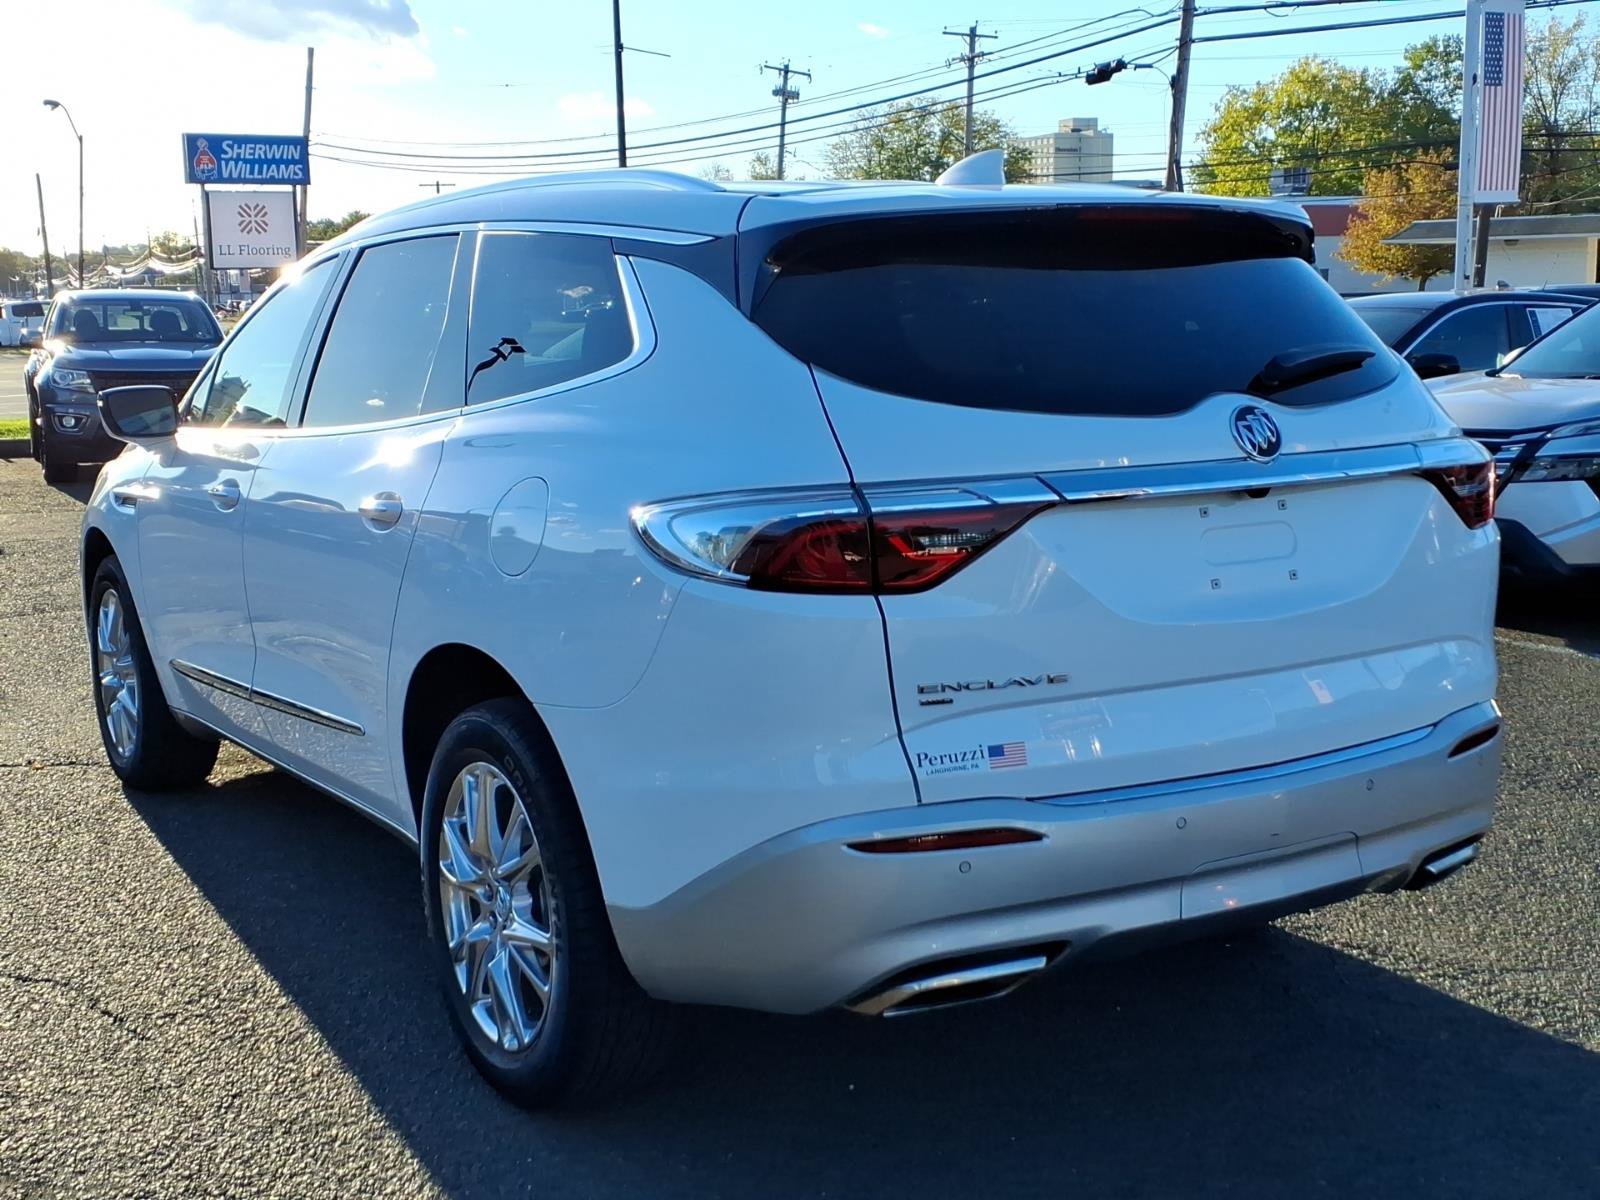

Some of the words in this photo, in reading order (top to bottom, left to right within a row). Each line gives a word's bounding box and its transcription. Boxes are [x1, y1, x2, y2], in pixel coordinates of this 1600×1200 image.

[221, 140, 301, 160] SHERWIN
[221, 160, 304, 179] WILLIAMS
[219, 244, 235, 256] LL
[238, 244, 292, 259] Flooring
[917, 674, 1069, 694] ENCLAVE
[916, 744, 985, 768] Peruzzi
[925, 765, 969, 776] LANGHORNE,
